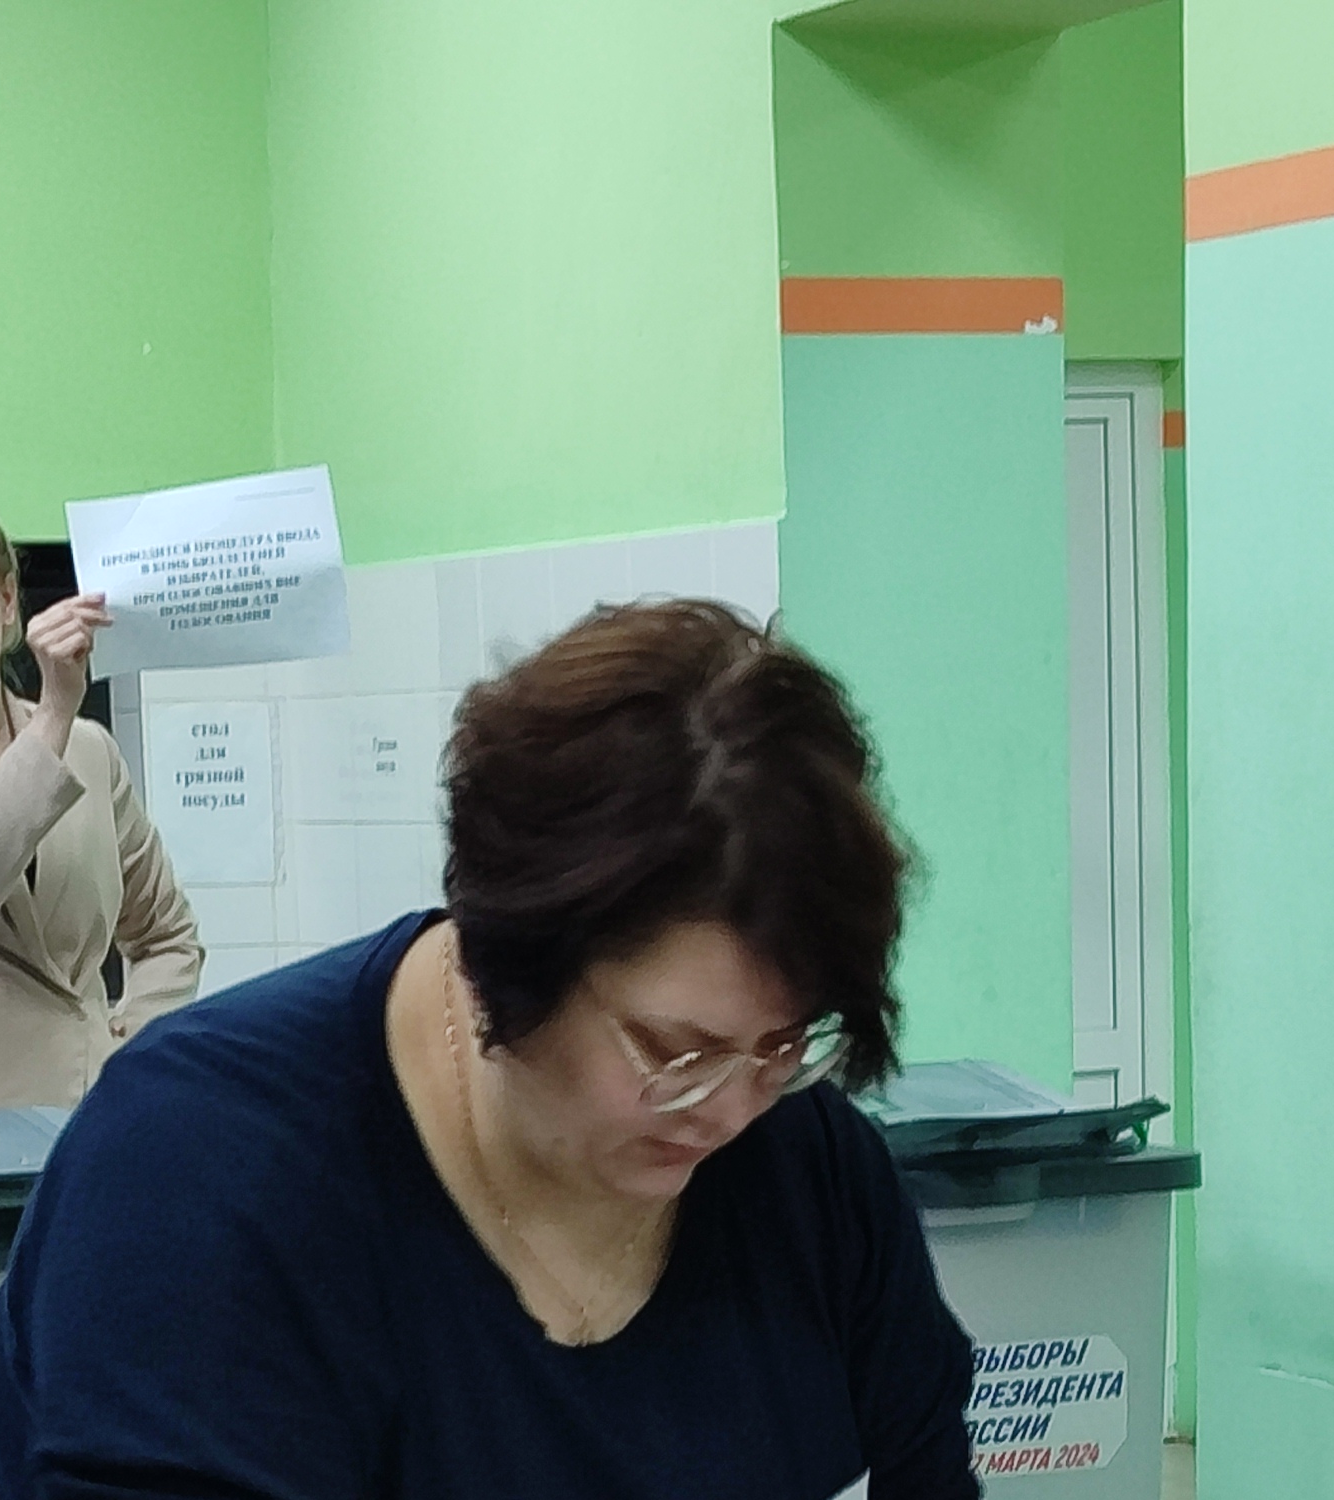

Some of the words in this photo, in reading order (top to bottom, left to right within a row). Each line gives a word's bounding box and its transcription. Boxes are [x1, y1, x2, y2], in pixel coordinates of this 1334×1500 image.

[182, 792, 245, 810] посуды
[964, 1370, 1124, 1411] РЕЗИДЕНТА
[965, 1413, 1052, 1446] ОССИИ
[985, 1448, 1051, 1474] МАРТА
[1054, 1443, 1100, 1469] 2024
